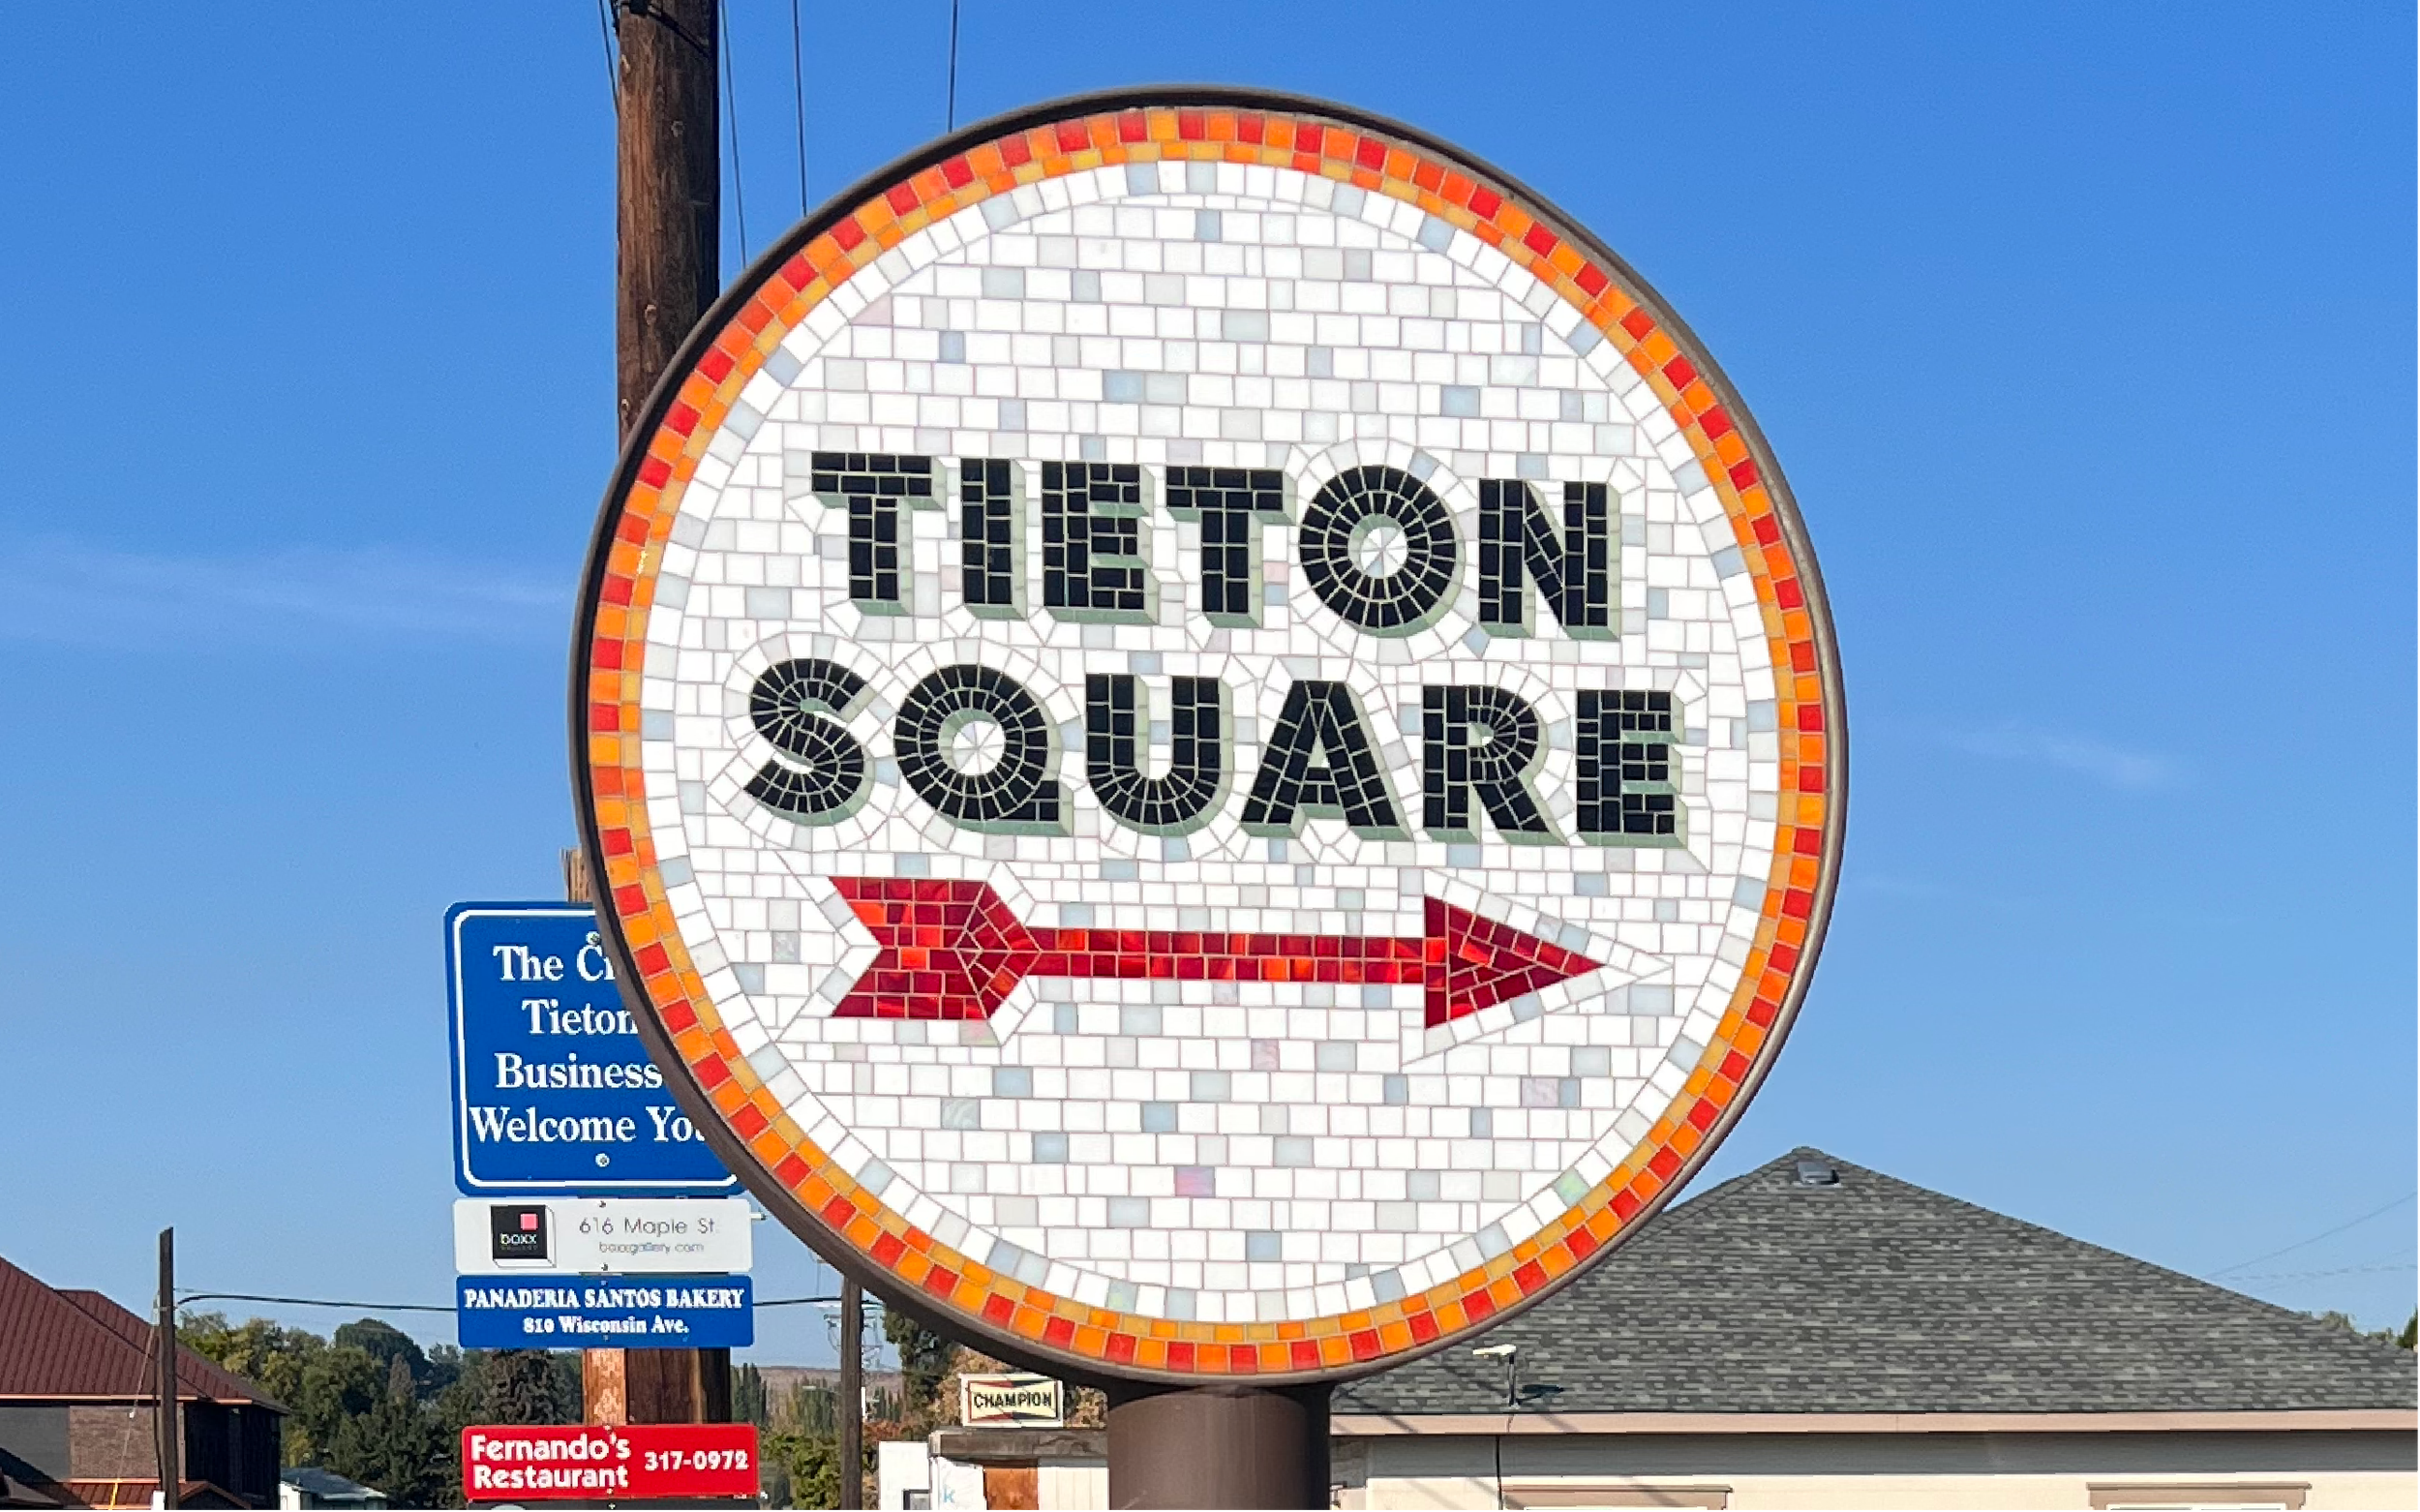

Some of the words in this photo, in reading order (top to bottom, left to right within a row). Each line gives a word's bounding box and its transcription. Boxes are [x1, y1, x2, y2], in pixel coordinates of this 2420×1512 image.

[810, 451, 1623, 639] TIETON
[742, 657, 1687, 848] SQUARE
[493, 945, 564, 981] The
[522, 999, 638, 1035] Tieton
[494, 1052, 663, 1088] Business
[469, 1106, 637, 1142] Welcome
[579, 1217, 614, 1234] 616
[624, 1217, 688, 1237] Maple
[464, 1288, 580, 1309] PANADERIA
[584, 1287, 662, 1309] SANTOS
[665, 1288, 745, 1308] BAKERY
[523, 1316, 555, 1333] 810
[558, 1315, 648, 1334] Wisconsin
[650, 1315, 690, 1334] Ave.
[973, 1391, 1052, 1409] CHAMPION
[470, 1433, 631, 1462] Fernando's
[644, 1449, 749, 1471] 317-0972
[472, 1464, 630, 1490] Restaurant
